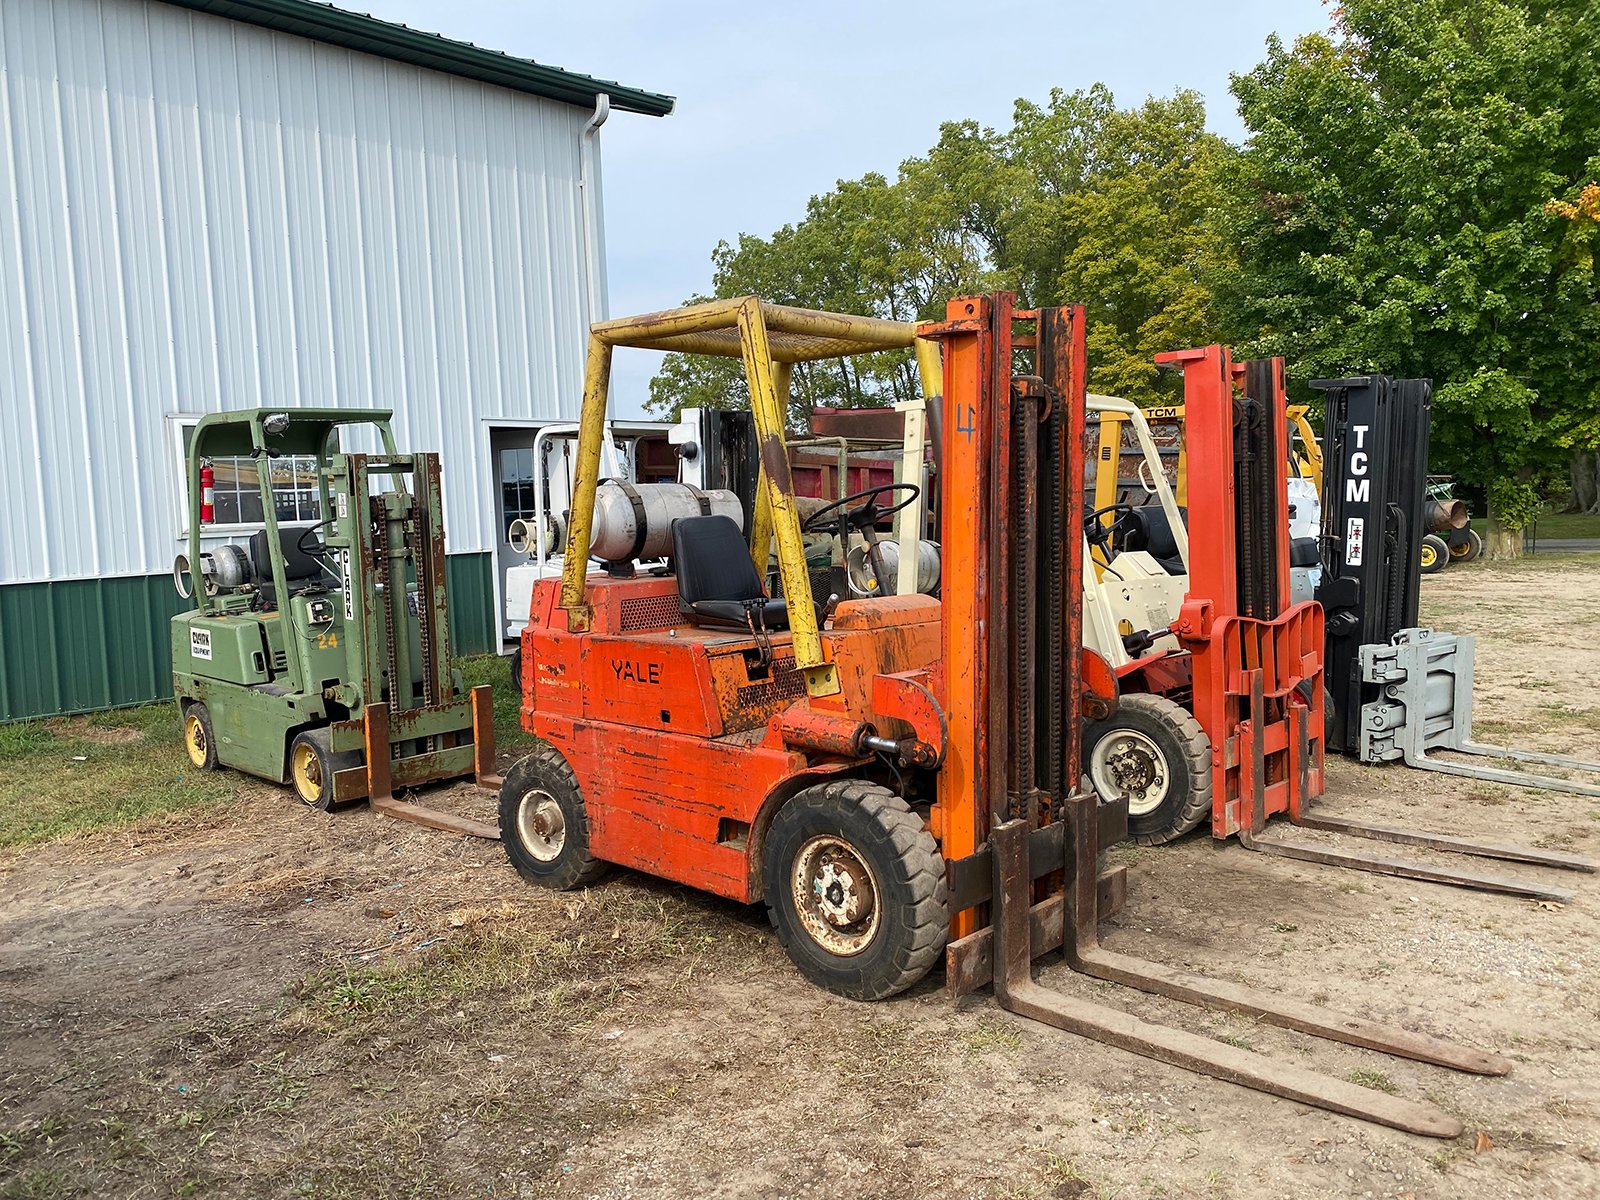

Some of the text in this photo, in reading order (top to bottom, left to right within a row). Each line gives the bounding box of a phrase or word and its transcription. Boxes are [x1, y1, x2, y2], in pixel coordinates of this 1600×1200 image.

[1146, 408, 1176, 418] TCM
[1346, 425, 1370, 503] TCM
[342, 550, 352, 618] CLARK
[192, 631, 210, 647] CLARK
[318, 632, 337, 649] 24
[611, 659, 660, 684] YALE
